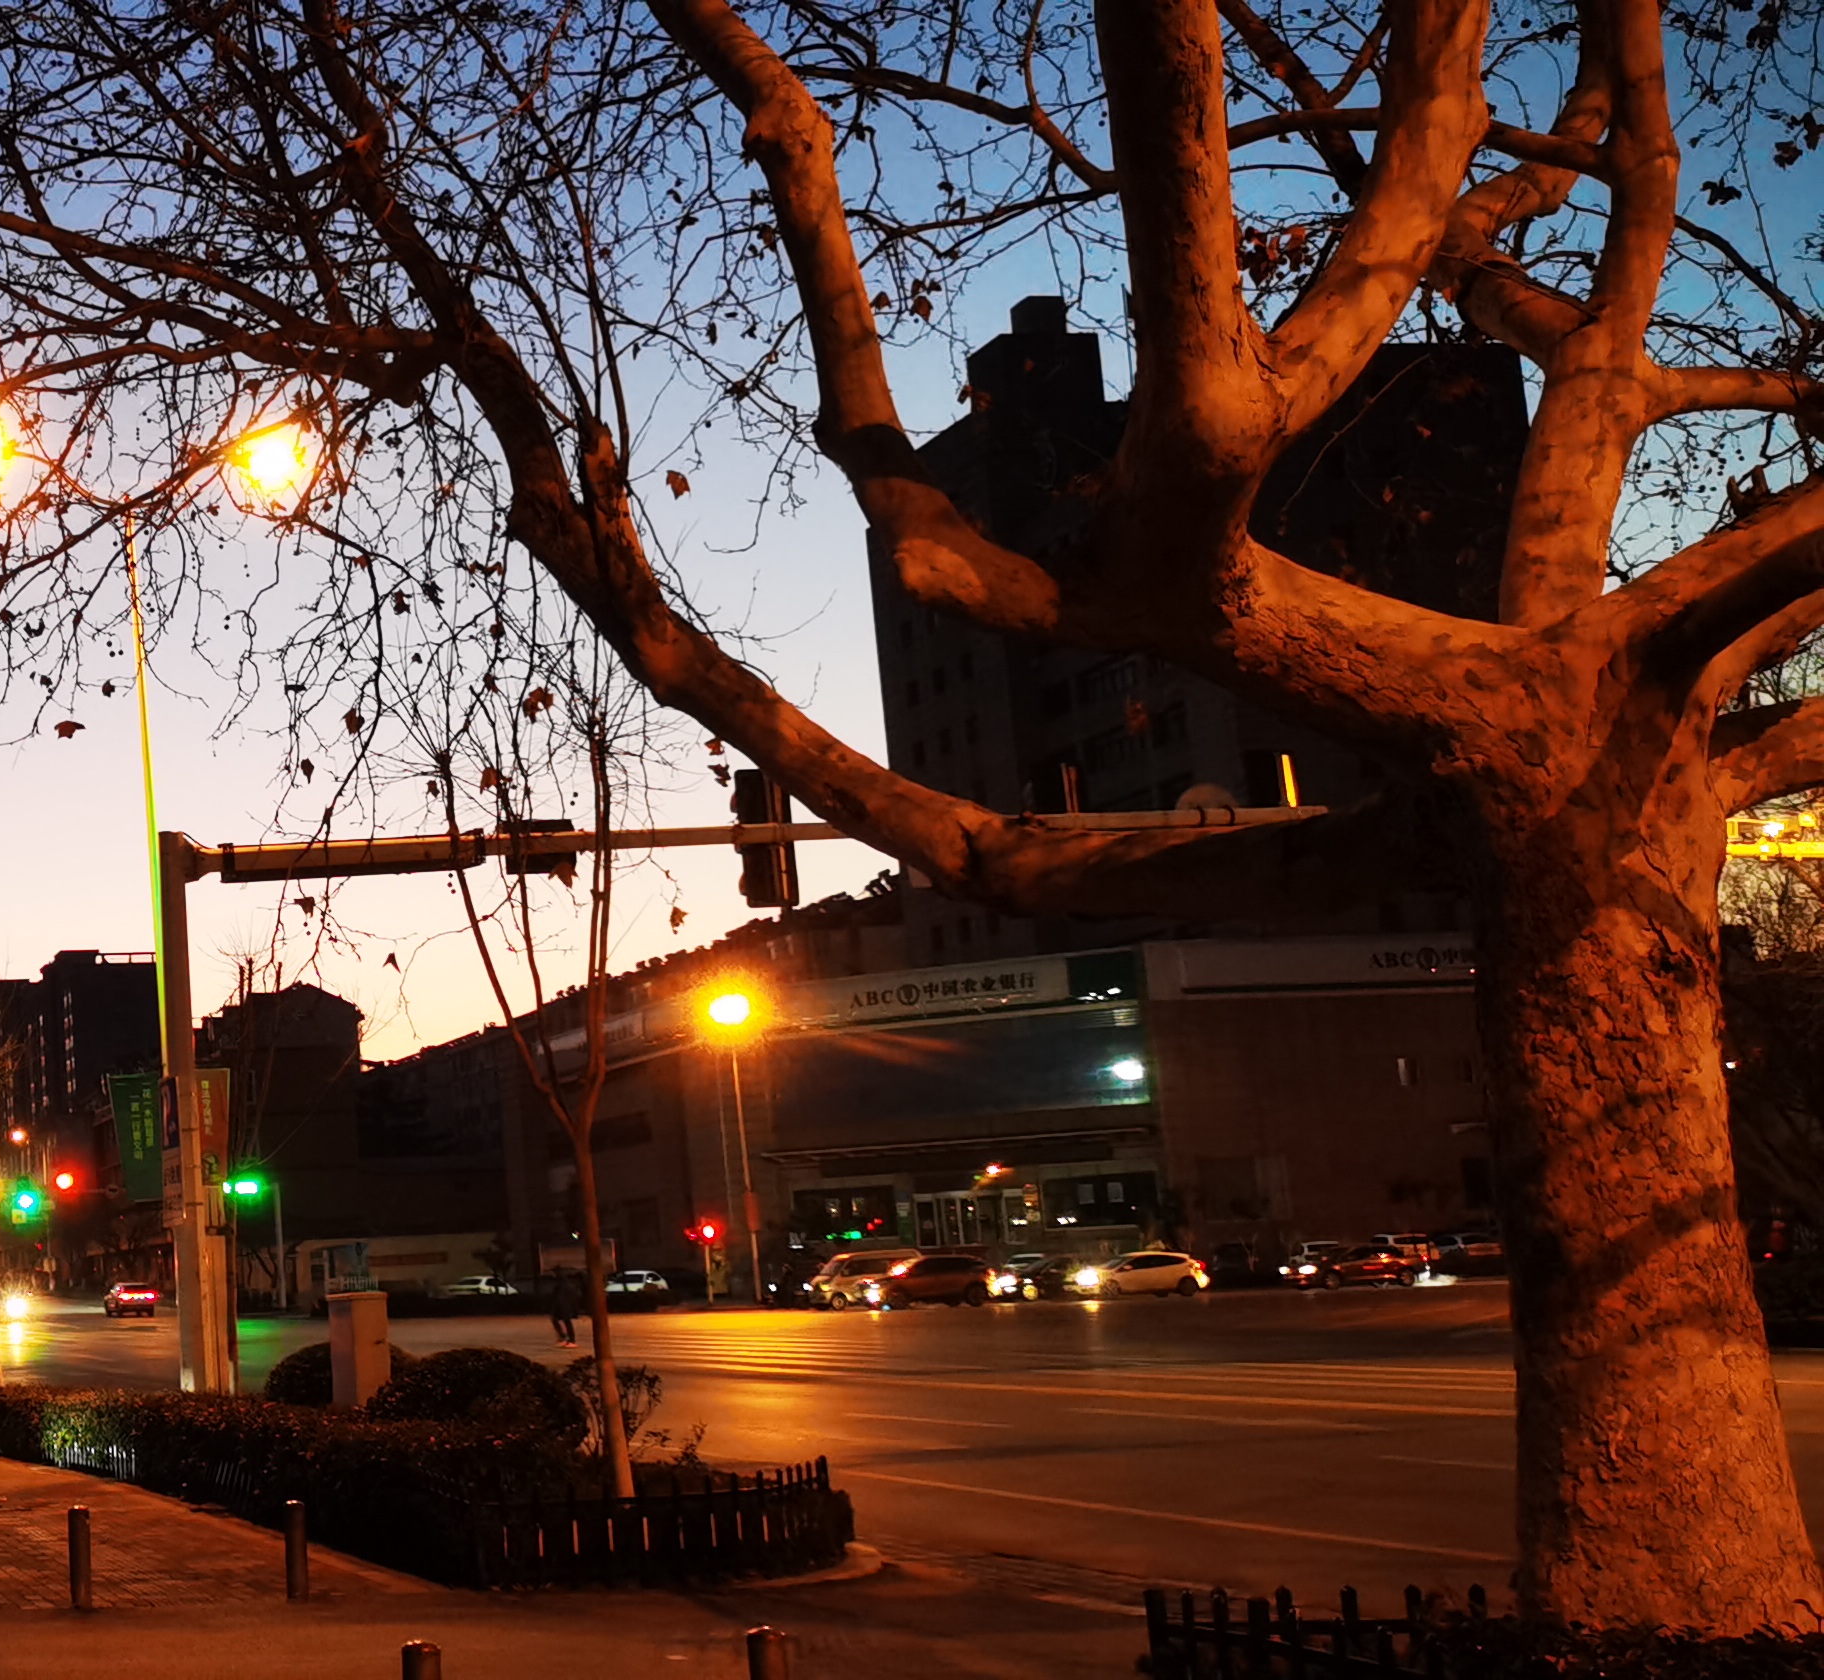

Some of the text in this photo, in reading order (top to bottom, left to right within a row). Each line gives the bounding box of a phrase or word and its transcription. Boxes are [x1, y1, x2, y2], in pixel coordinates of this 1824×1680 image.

[1369, 951, 1414, 969] ABC
[850, 972, 1036, 1009] ABC 中国农业银行
